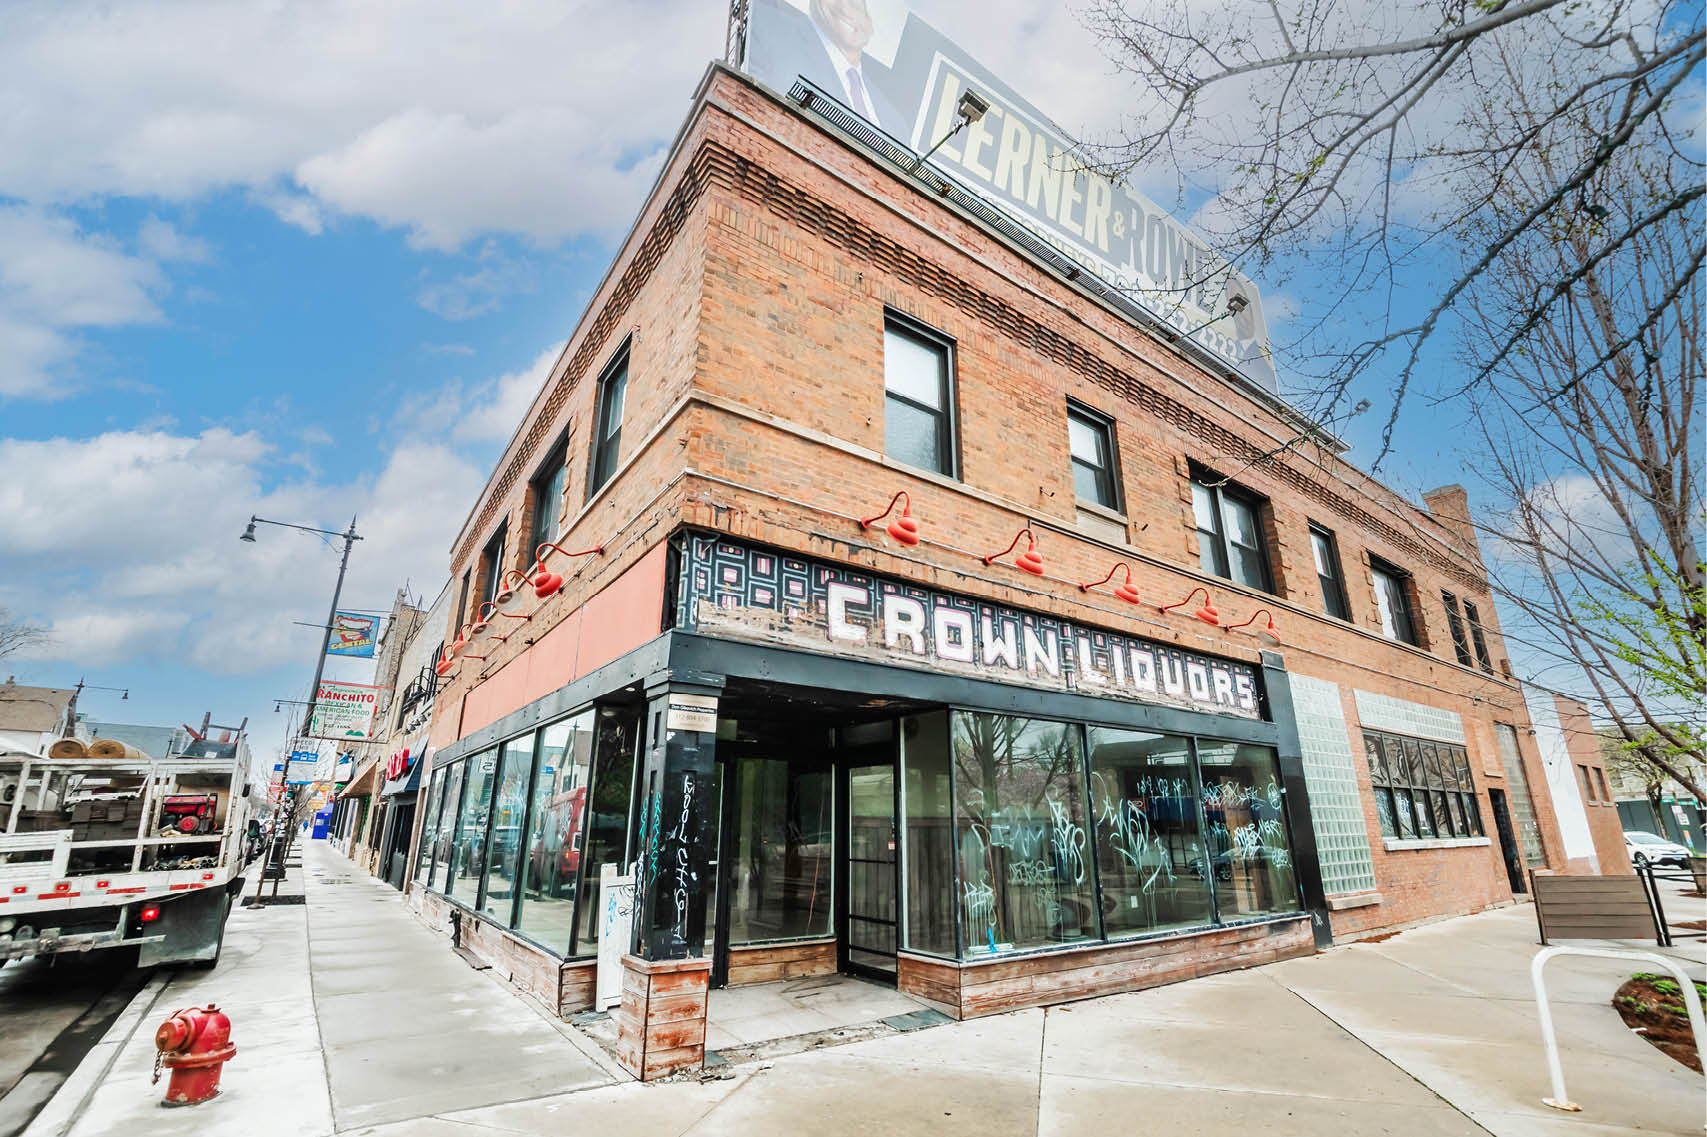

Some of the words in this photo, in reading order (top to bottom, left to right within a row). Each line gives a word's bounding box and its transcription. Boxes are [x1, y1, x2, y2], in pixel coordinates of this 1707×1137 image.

[929, 72, 1113, 253] LERNER
[828, 582, 1059, 677] CROWN
[1077, 636, 1255, 708] LIQUORS
[314, 705, 350, 715] AMERICAN
[351, 708, 370, 716] FOOD
[317, 688, 375, 703] RANCHITO
